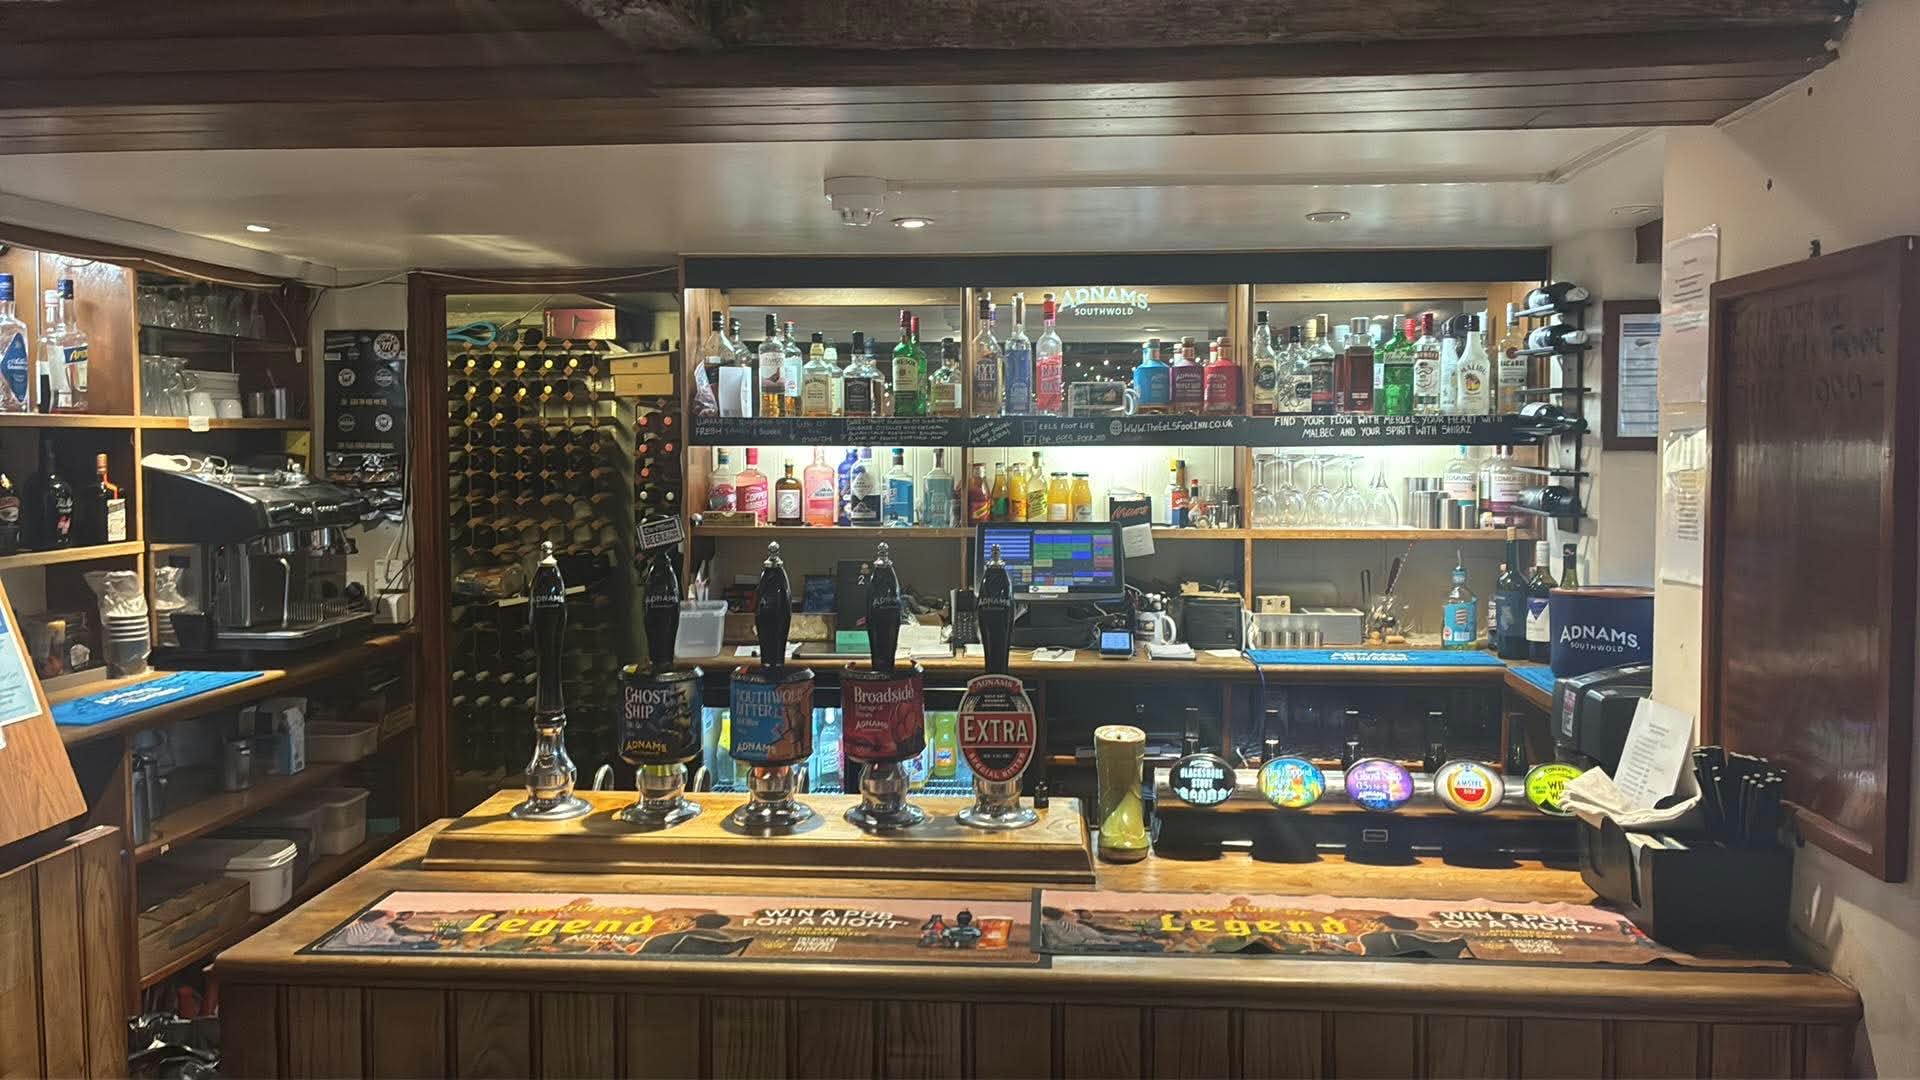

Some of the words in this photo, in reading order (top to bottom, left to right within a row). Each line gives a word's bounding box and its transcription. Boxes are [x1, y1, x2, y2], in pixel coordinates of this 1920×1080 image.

[1074, 308, 1134, 316] SOUTHWOLD
[1274, 417, 1296, 426] FIND
[1302, 417, 1325, 426] YOUR
[1329, 416, 1353, 425] FLOW
[1357, 416, 1380, 425] WITH
[1302, 428, 1335, 439] MALBEC
[1339, 427, 1356, 437] AND
[1361, 426, 1381, 437] YOUR
[1386, 426, 1411, 436] SPIRIT
[1415, 426, 1437, 436] WITH
[1441, 426, 1472, 435] SHIRAZ
[1570, 641, 1624, 653] SOUTHWOLD
[624, 687, 670, 705] GHOST
[854, 679, 914, 704] Broadside
[624, 702, 654, 719] SHIP
[855, 719, 889, 730] ADNAMS
[963, 715, 1029, 744] EXTRA
[625, 740, 668, 753] ADNAMS
[736, 742, 777, 754] ADNAMS
[968, 752, 1000, 779] SPECIAL
[765, 908, 815, 918] WIN
[820, 909, 837, 918] A
[843, 910, 895, 920] PUB
[1441, 911, 1494, 921] WIN
[1501, 913, 1518, 921] A
[1523, 914, 1578, 925] PUB
[463, 913, 656, 938] Legend
[743, 917, 794, 927] FOR
[798, 918, 816, 926] A
[1160, 914, 1348, 937] Legend
[1428, 920, 1482, 929] FOR
[1489, 920, 1506, 928] A
